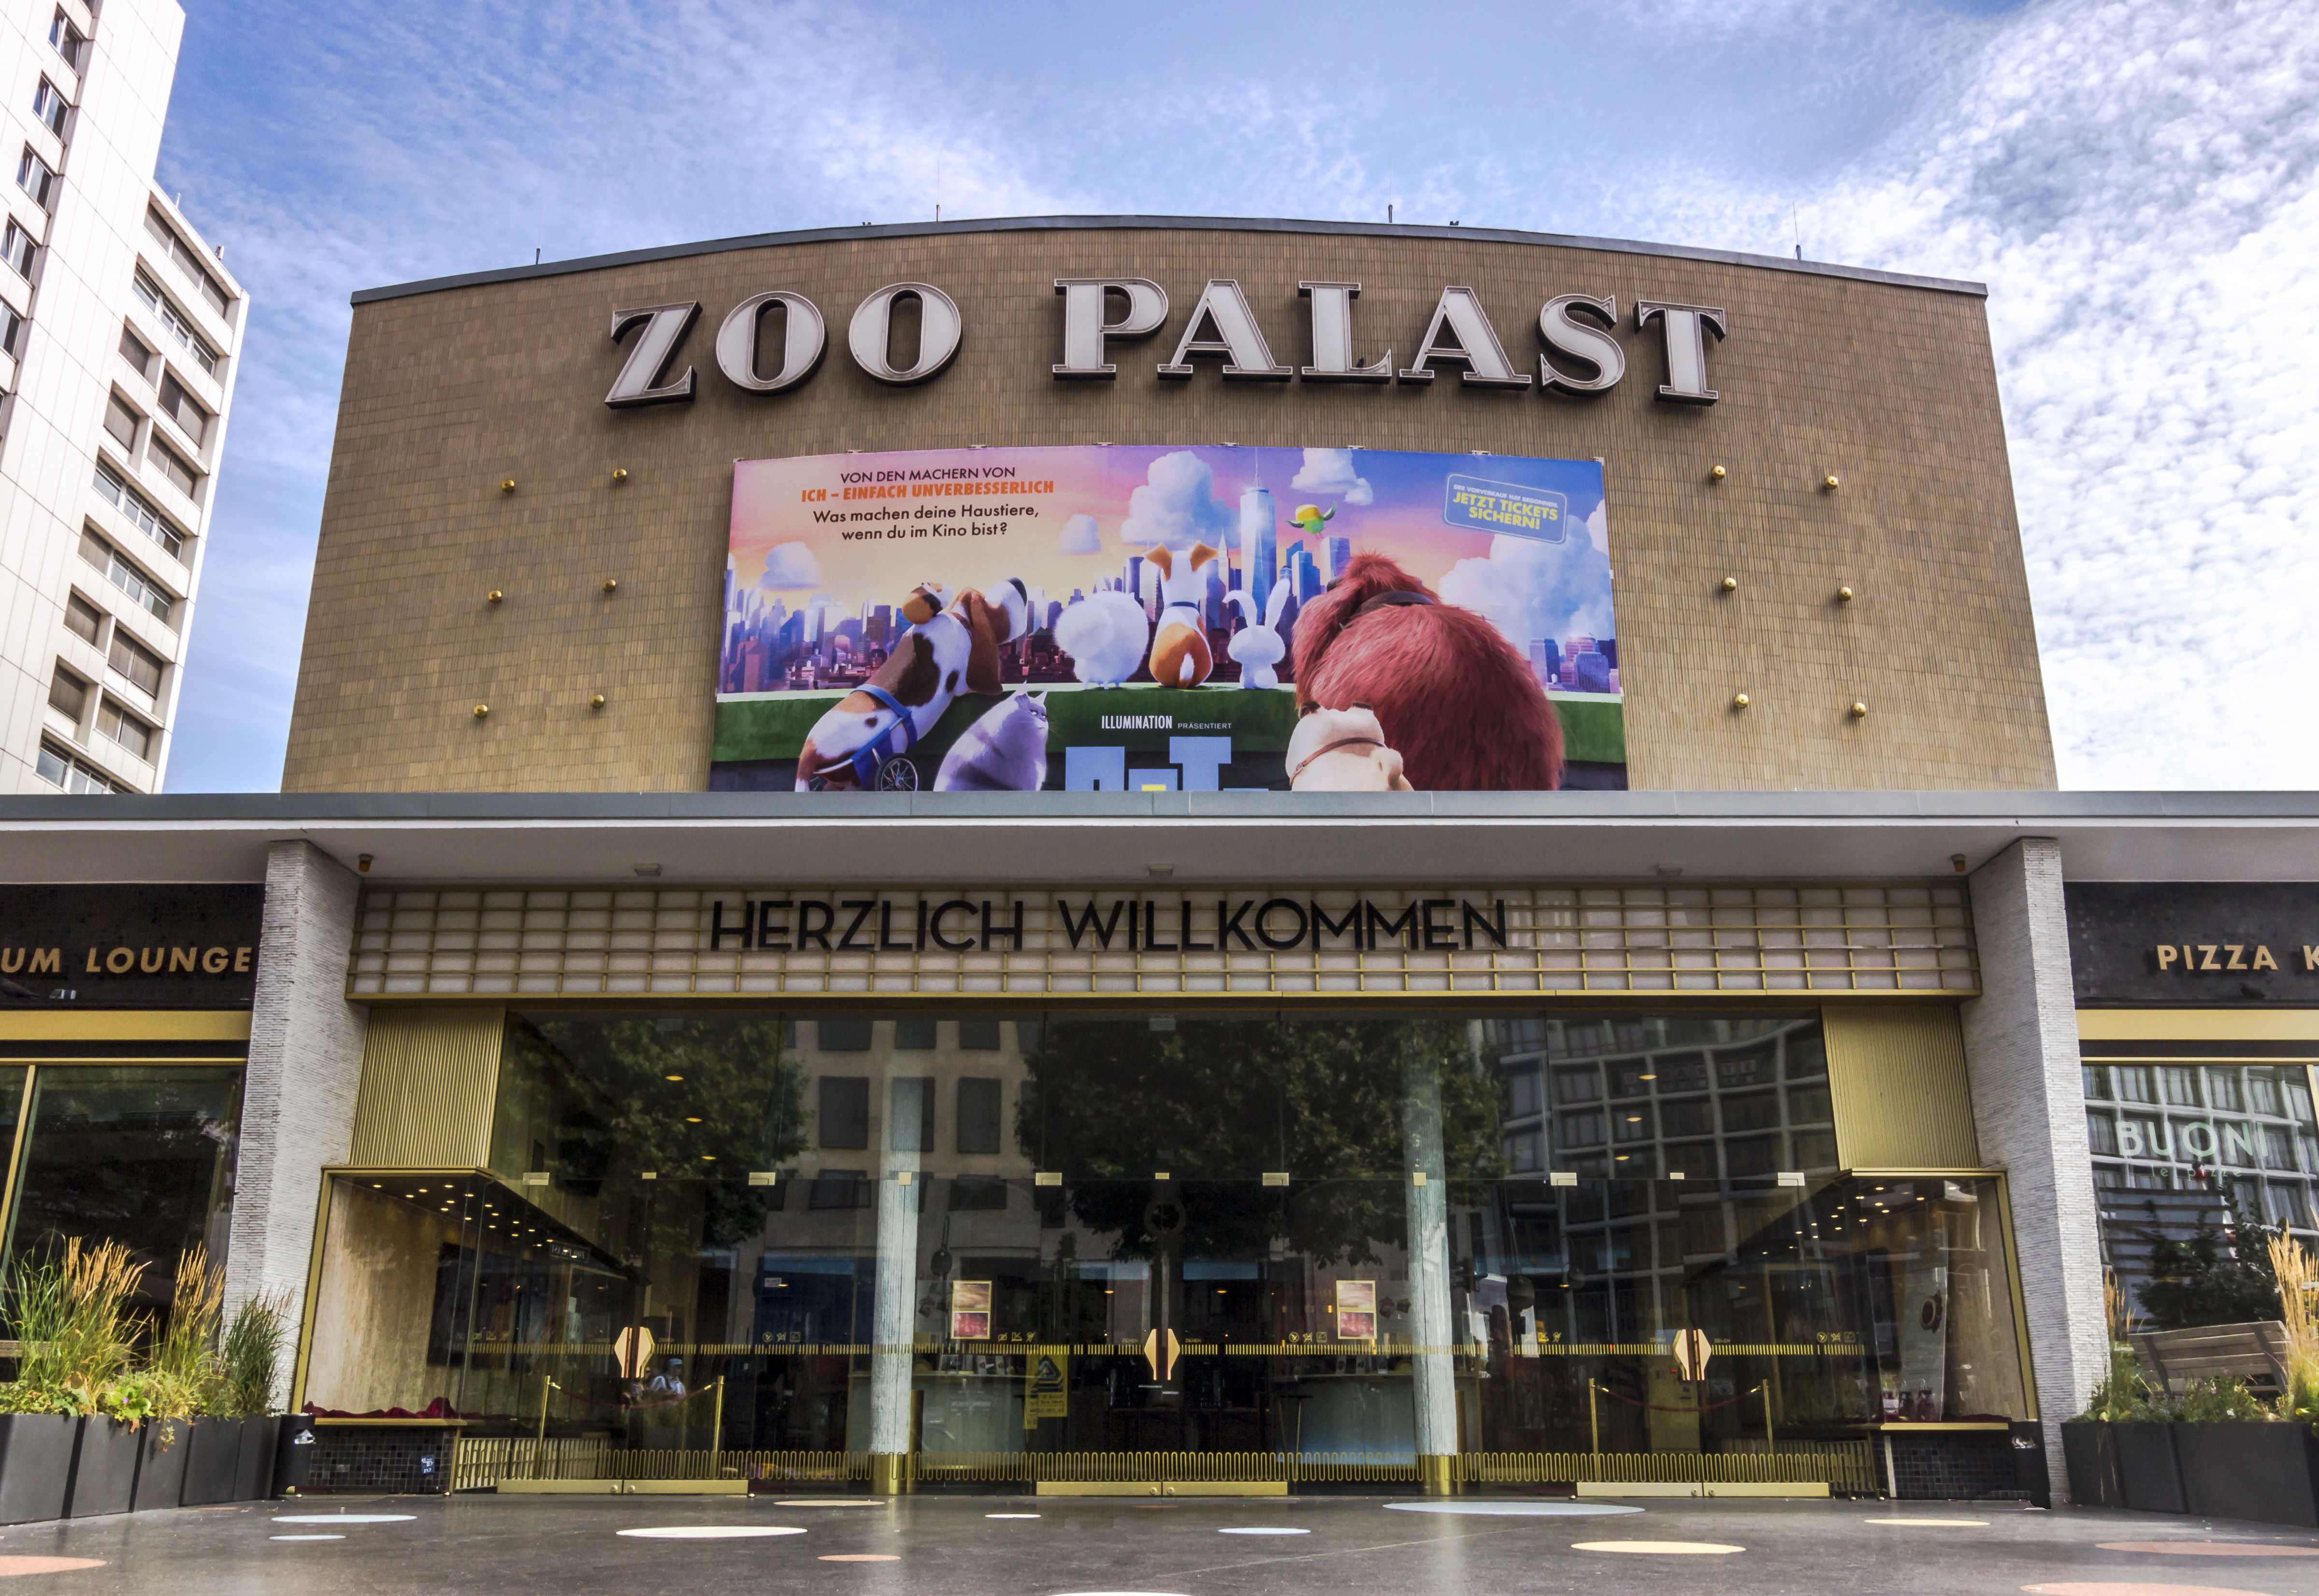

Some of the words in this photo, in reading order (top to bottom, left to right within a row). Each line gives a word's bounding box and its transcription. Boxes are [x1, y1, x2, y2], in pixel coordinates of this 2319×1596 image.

[604, 282, 963, 409] ZOO
[1052, 276, 1727, 407] PALAST
[840, 472, 873, 483] VON
[876, 471, 905, 482] DEN
[908, 468, 979, 480] MACHERN
[981, 467, 1015, 478] VON
[801, 489, 826, 502] ICH
[843, 485, 907, 500] EINFACH
[911, 480, 1054, 497] UNVERBESSERLICH
[1467, 487, 1508, 498] VORVERKAUF
[813, 509, 847, 523] Was
[850, 506, 909, 521] machen
[914, 504, 956, 519] deine
[961, 503, 1039, 519] Haustiere,
[1453, 492, 1496, 509] JETZT
[1499, 499, 1558, 520] TICKETS
[1469, 506, 1541, 530] SICHERN!
[841, 529, 882, 541] wenn
[887, 524, 907, 539] du
[910, 525, 927, 538] im
[933, 523, 967, 537] Kino
[971, 522, 1008, 536] bist?
[1101, 715, 1173, 729] ILLUMINATION
[710, 900, 1023, 952] HERZLICH
[1057, 898, 1507, 951] WILLKOMMEN
[0, 948, 61, 973] UM
[86, 947, 252, 973] LOUNGE
[2157, 945, 2278, 970] PIZZA
[2116, 1121, 2269, 1157] BUONI
[2151, 1164, 2169, 1177] le
